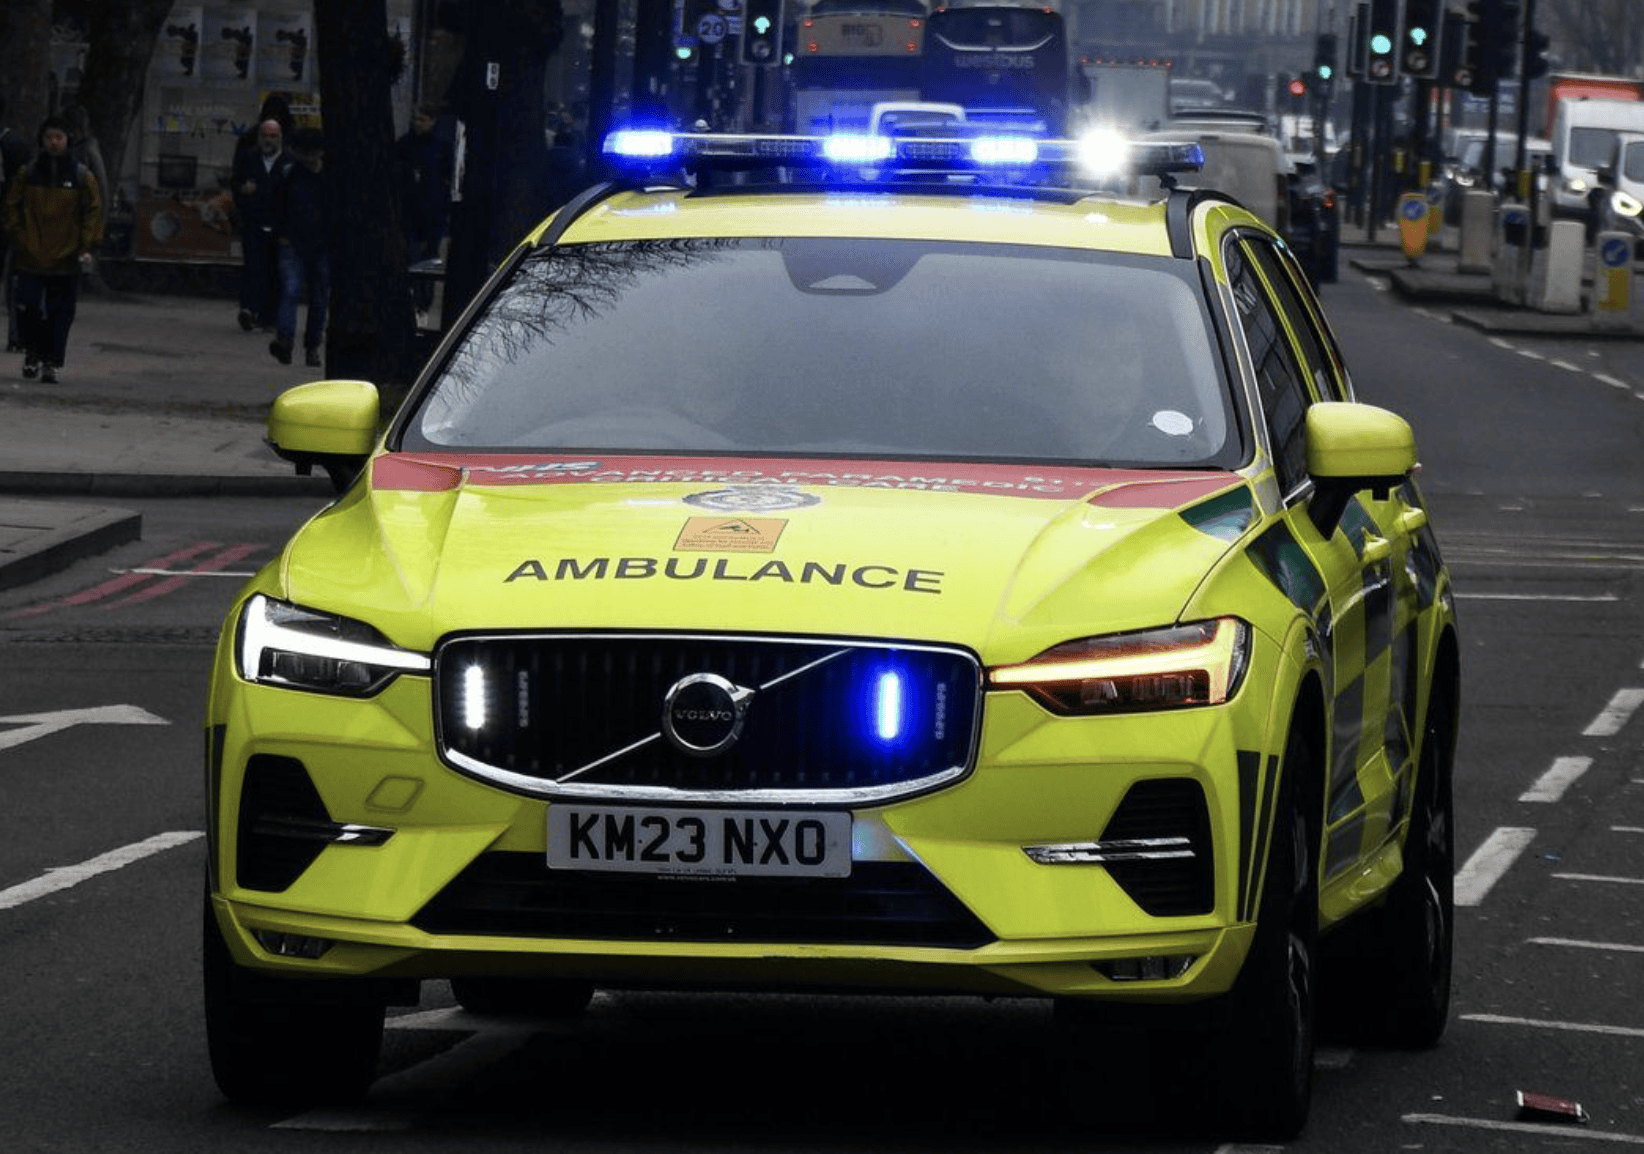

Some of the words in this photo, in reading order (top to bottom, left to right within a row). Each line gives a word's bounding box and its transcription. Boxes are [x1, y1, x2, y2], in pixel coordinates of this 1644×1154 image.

[701, 20, 724, 36] 20
[780, 471, 1064, 492] PARAMEDIC
[503, 557, 945, 594] AMBULANCE
[673, 709, 733, 721] VOLVO
[570, 812, 706, 863] KM23
[724, 817, 826, 866] NXO
